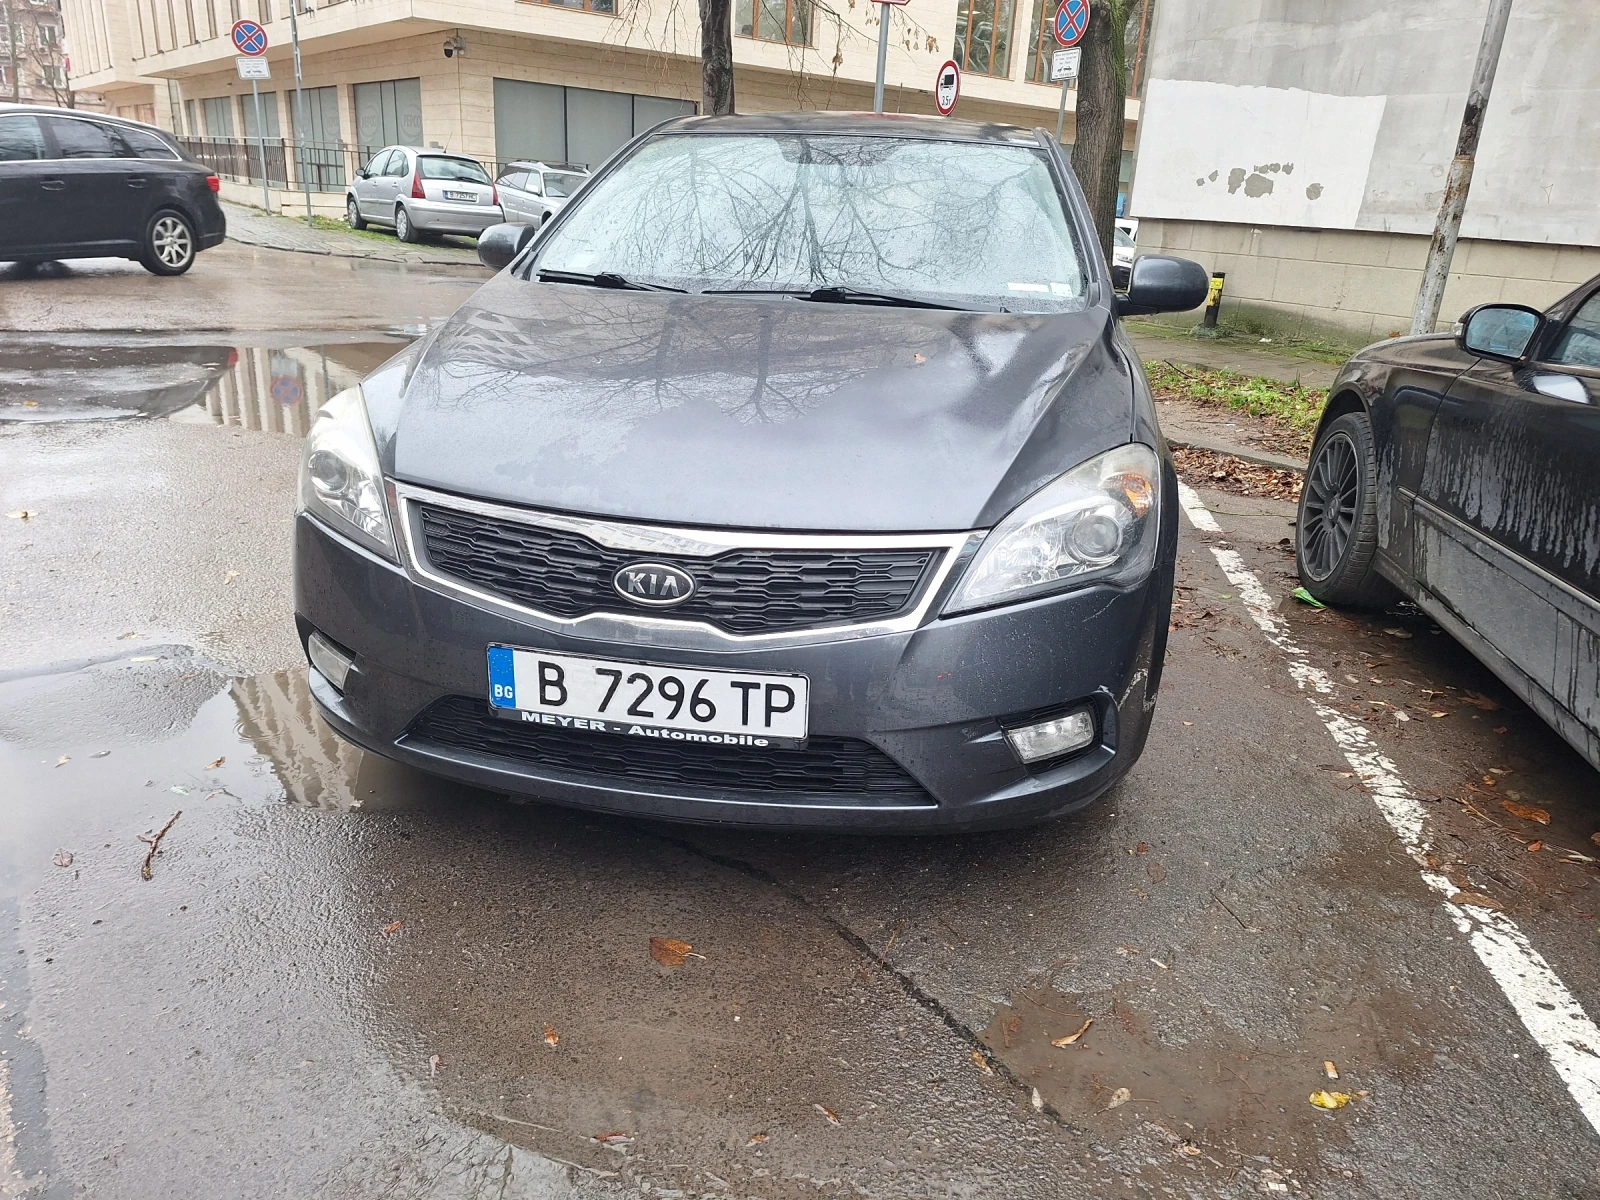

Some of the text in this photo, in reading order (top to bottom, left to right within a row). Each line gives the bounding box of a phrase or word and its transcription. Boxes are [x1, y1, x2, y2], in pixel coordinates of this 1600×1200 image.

[626, 571, 680, 597] KIA
[494, 683, 513, 699] BG
[538, 660, 796, 728] B 7296 TP
[521, 711, 606, 731] MEYER
[627, 725, 769, 747] Automobile
